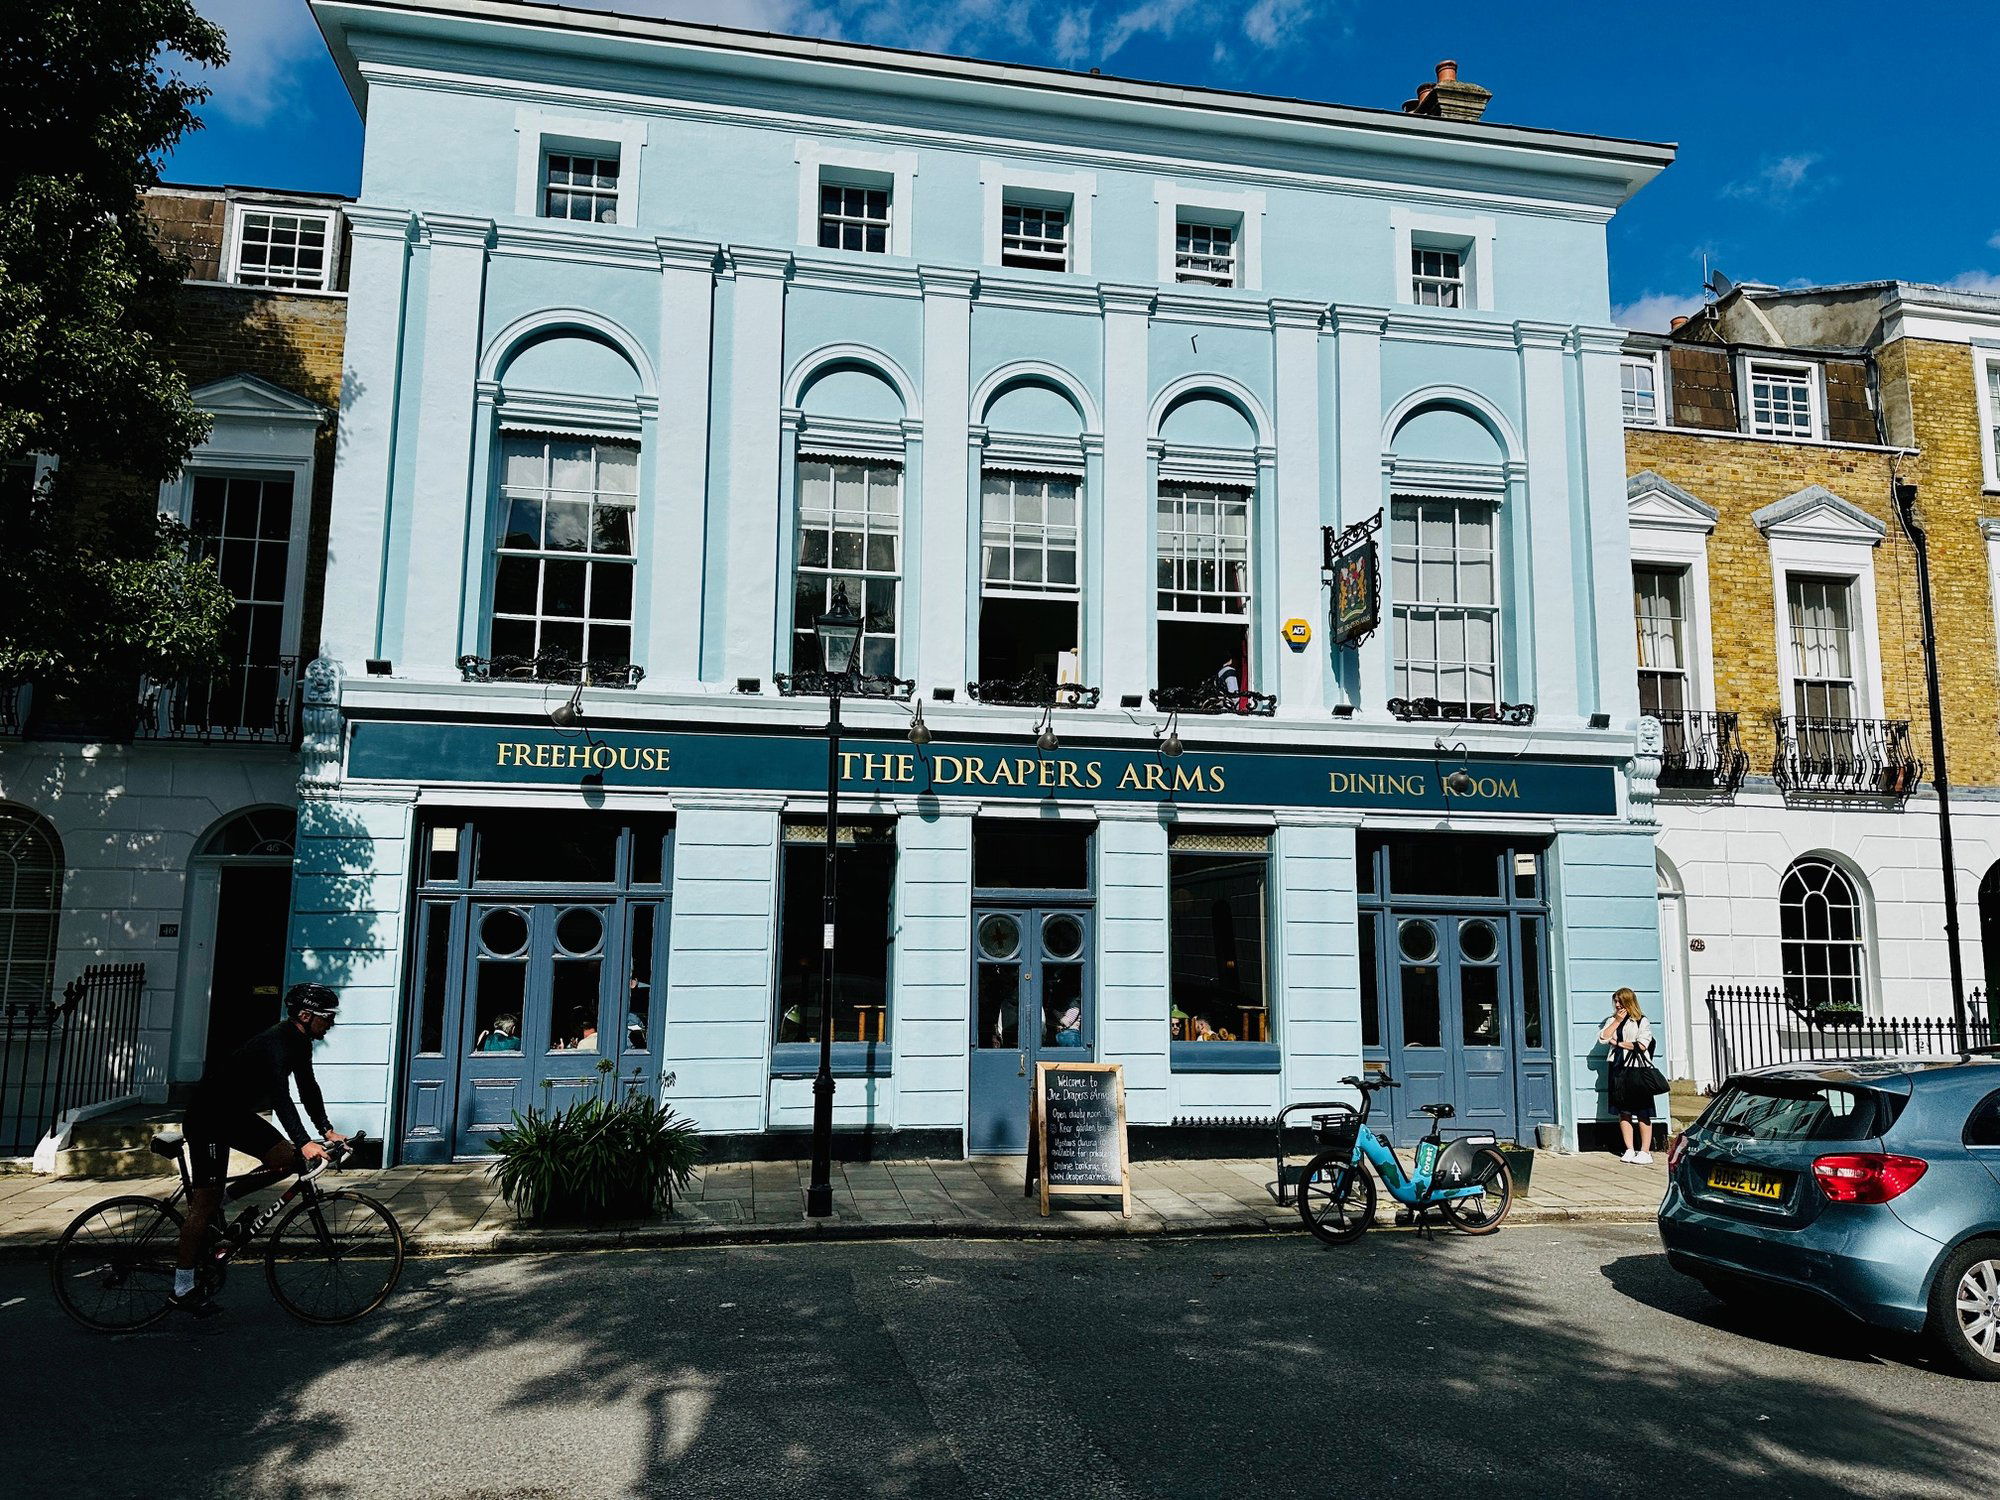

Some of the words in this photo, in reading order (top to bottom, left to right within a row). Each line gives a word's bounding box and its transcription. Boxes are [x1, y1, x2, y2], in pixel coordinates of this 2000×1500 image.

[1293, 627, 1305, 635] ADT
[497, 742, 671, 772] FREEHOUSE
[838, 752, 915, 782] THE
[932, 755, 1102, 789] DRAPERS
[1116, 762, 1226, 793] ARMS
[1328, 772, 1426, 797] DINING
[1057, 1074, 1086, 1087] Welcome
[1090, 1075, 1098, 1087] to
[1047, 1089, 1060, 1100] The
[1063, 1089, 1089, 1106] Drapers
[1052, 1108, 1067, 1122] Open
[1421, 1146, 1433, 1176] forest
[1713, 1167, 1745, 1190] BD62
